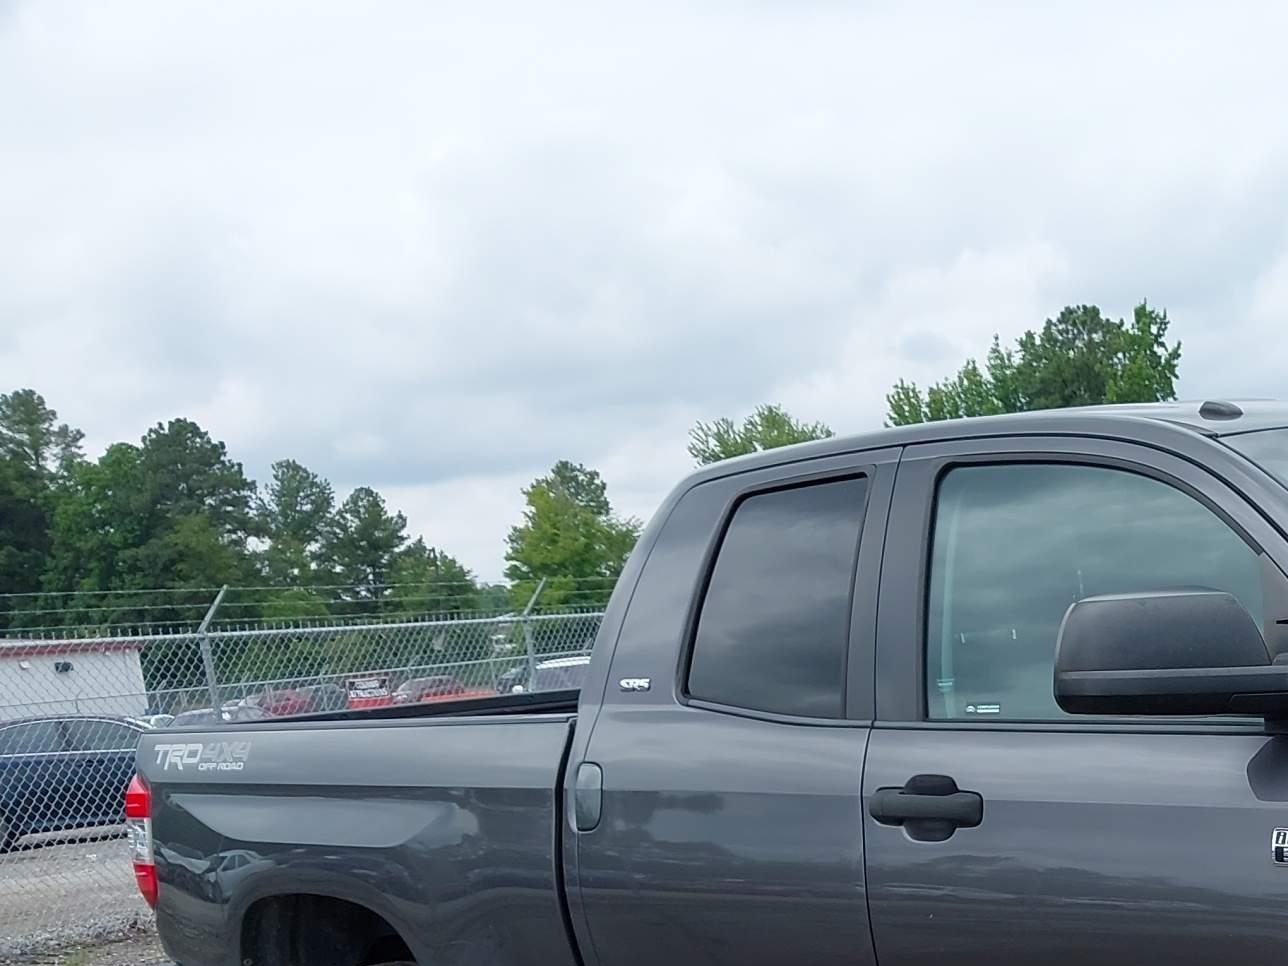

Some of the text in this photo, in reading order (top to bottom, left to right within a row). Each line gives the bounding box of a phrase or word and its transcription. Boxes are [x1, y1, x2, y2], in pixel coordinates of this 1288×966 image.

[154, 743, 203, 770] TRD
[198, 762, 244, 770] OFF ROAD
